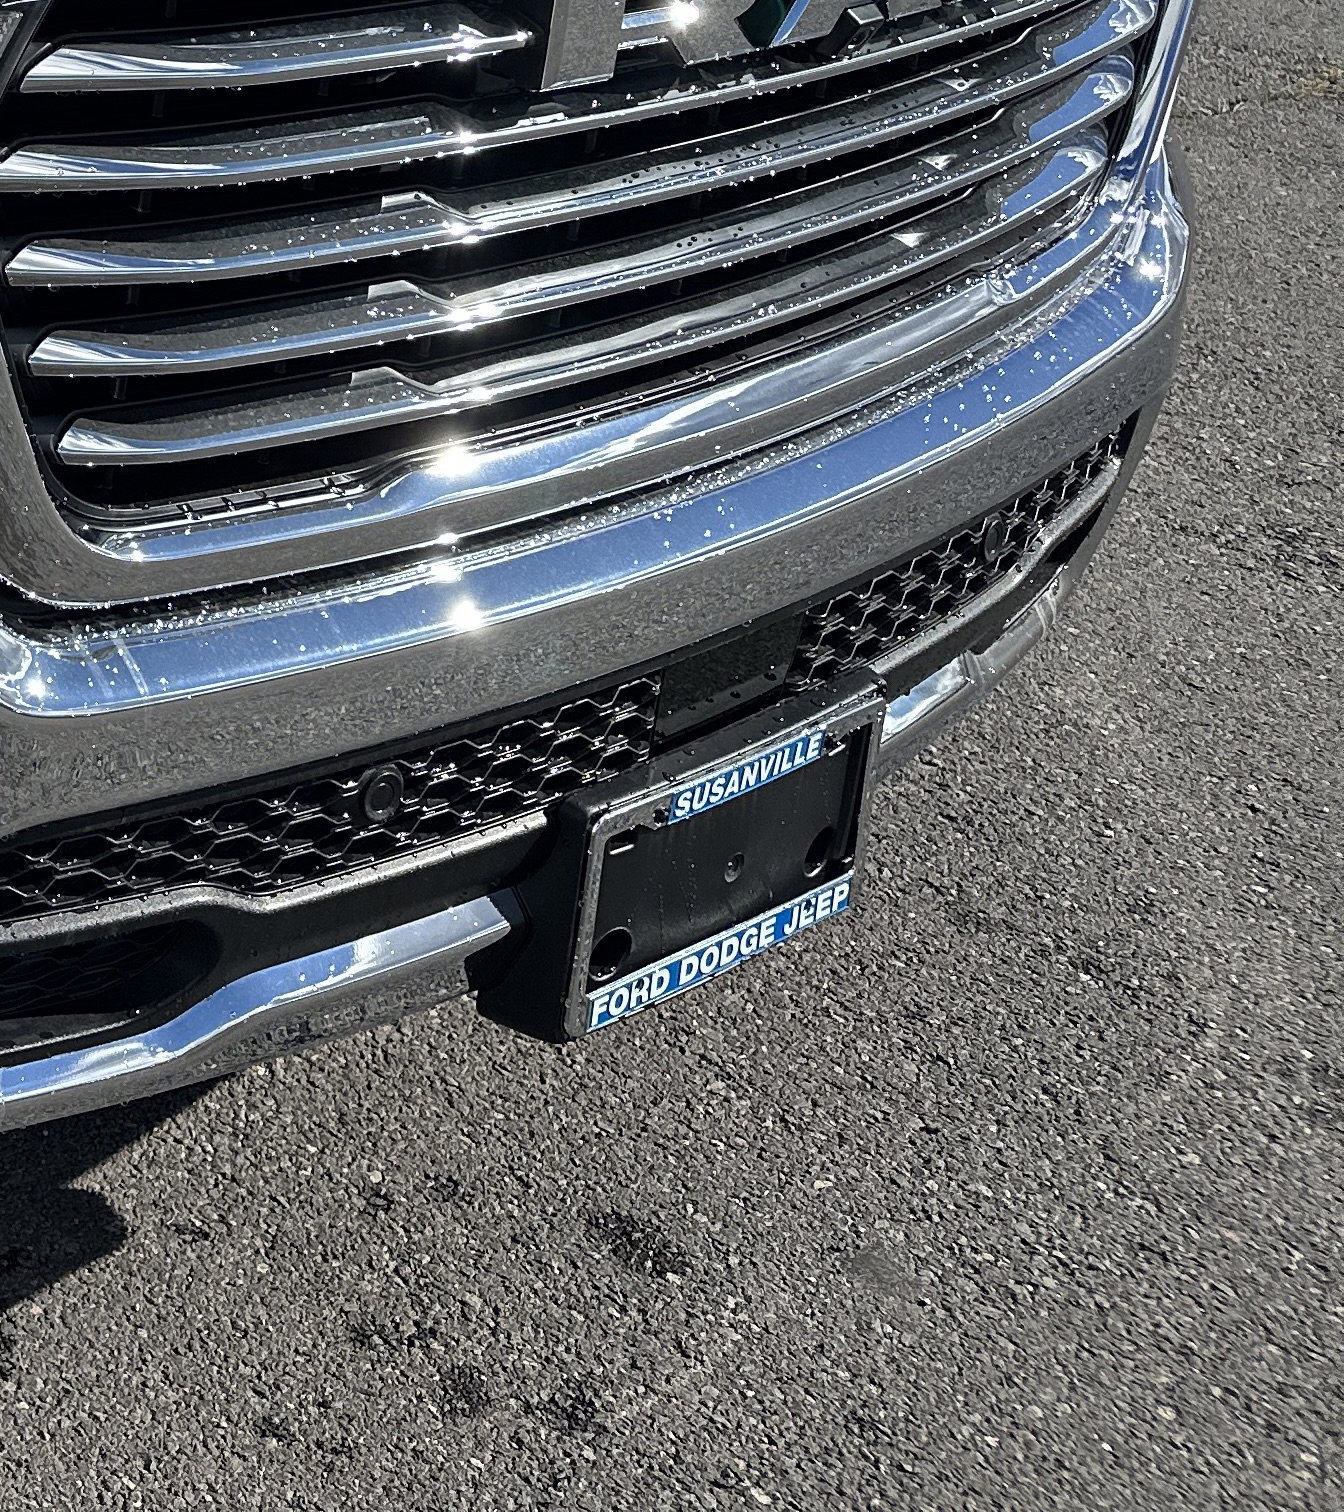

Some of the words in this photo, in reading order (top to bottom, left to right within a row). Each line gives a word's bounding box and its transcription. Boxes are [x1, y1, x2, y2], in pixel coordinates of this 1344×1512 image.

[674, 733, 822, 819] SUSANVILLE
[590, 968, 670, 1028] FORD
[679, 915, 776, 983] DODGE
[783, 884, 850, 935] JEEP
